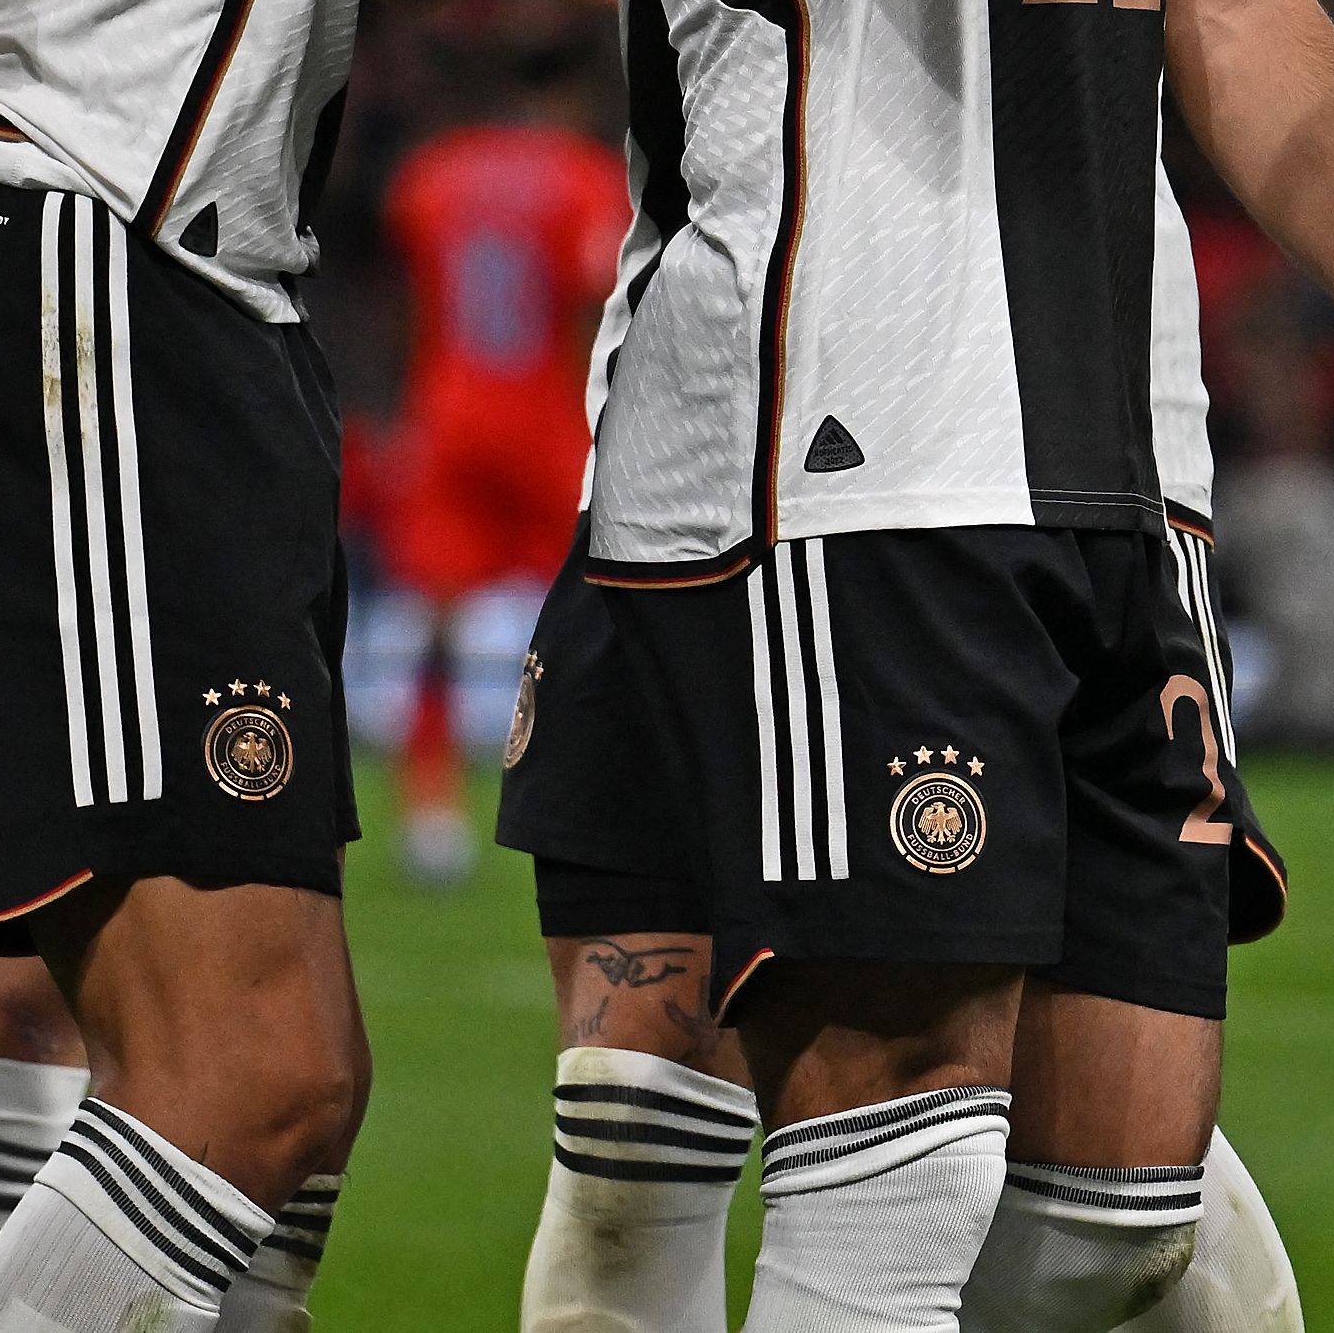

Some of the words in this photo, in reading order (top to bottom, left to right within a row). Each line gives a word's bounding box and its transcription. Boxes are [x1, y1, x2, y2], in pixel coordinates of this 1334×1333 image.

[225, 717, 276, 737] DEUTSCHER
[911, 786, 967, 806] DEUTSCHER
[906, 833, 975, 861] FUSSBALL-BUND
